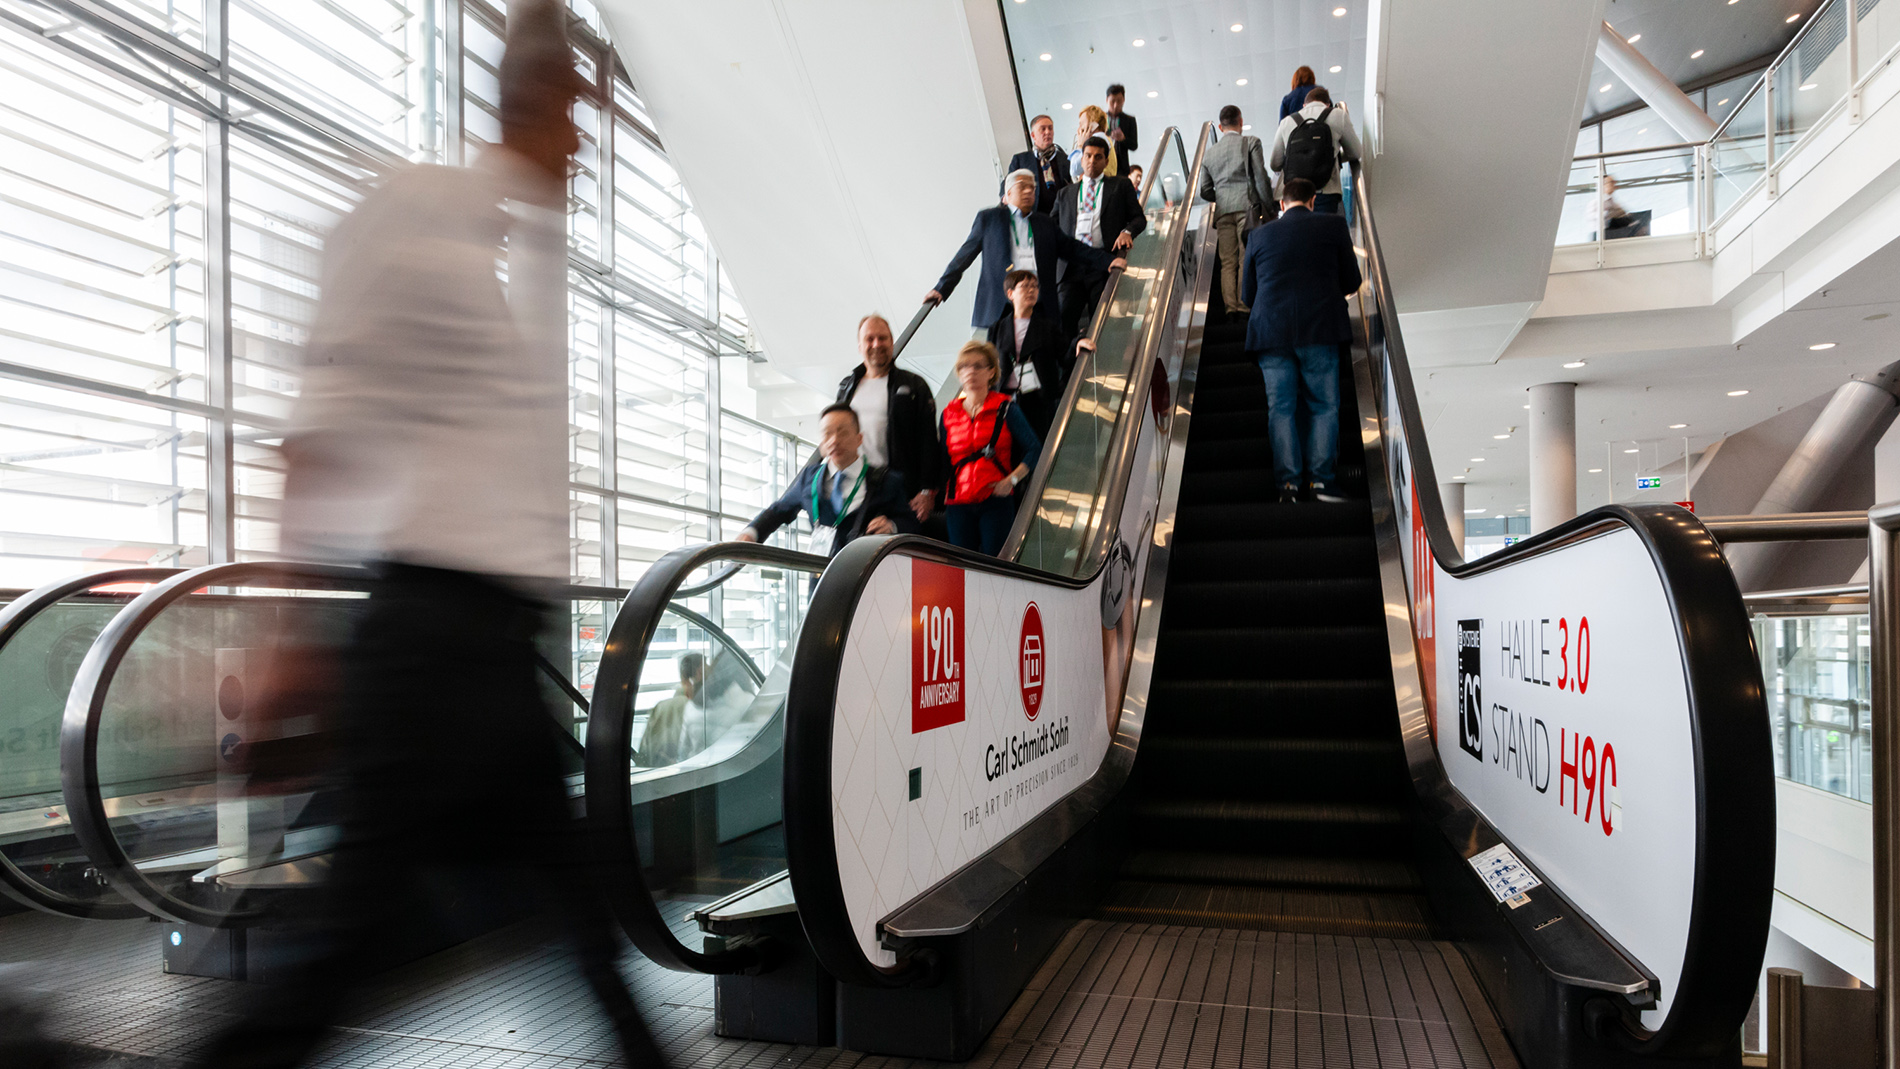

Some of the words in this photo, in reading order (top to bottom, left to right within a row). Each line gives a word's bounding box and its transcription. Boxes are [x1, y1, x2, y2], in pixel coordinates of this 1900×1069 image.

[1500, 618, 1551, 687] HALLE
[1557, 615, 1591, 695] 3.0
[919, 681, 960, 709] ANNIVERSARY
[1028, 692, 1038, 706] 1829
[1464, 672, 1482, 752] CS
[985, 737, 1009, 782] Carl
[1011, 723, 1049, 771] Schmidt
[1491, 702, 1551, 795] STAND
[963, 806, 980, 831] THE
[984, 795, 1000, 819] ART
[1003, 788, 1013, 808] OF
[1016, 772, 1049, 800] PRECISION
[1050, 759, 1066, 780] SINCE
